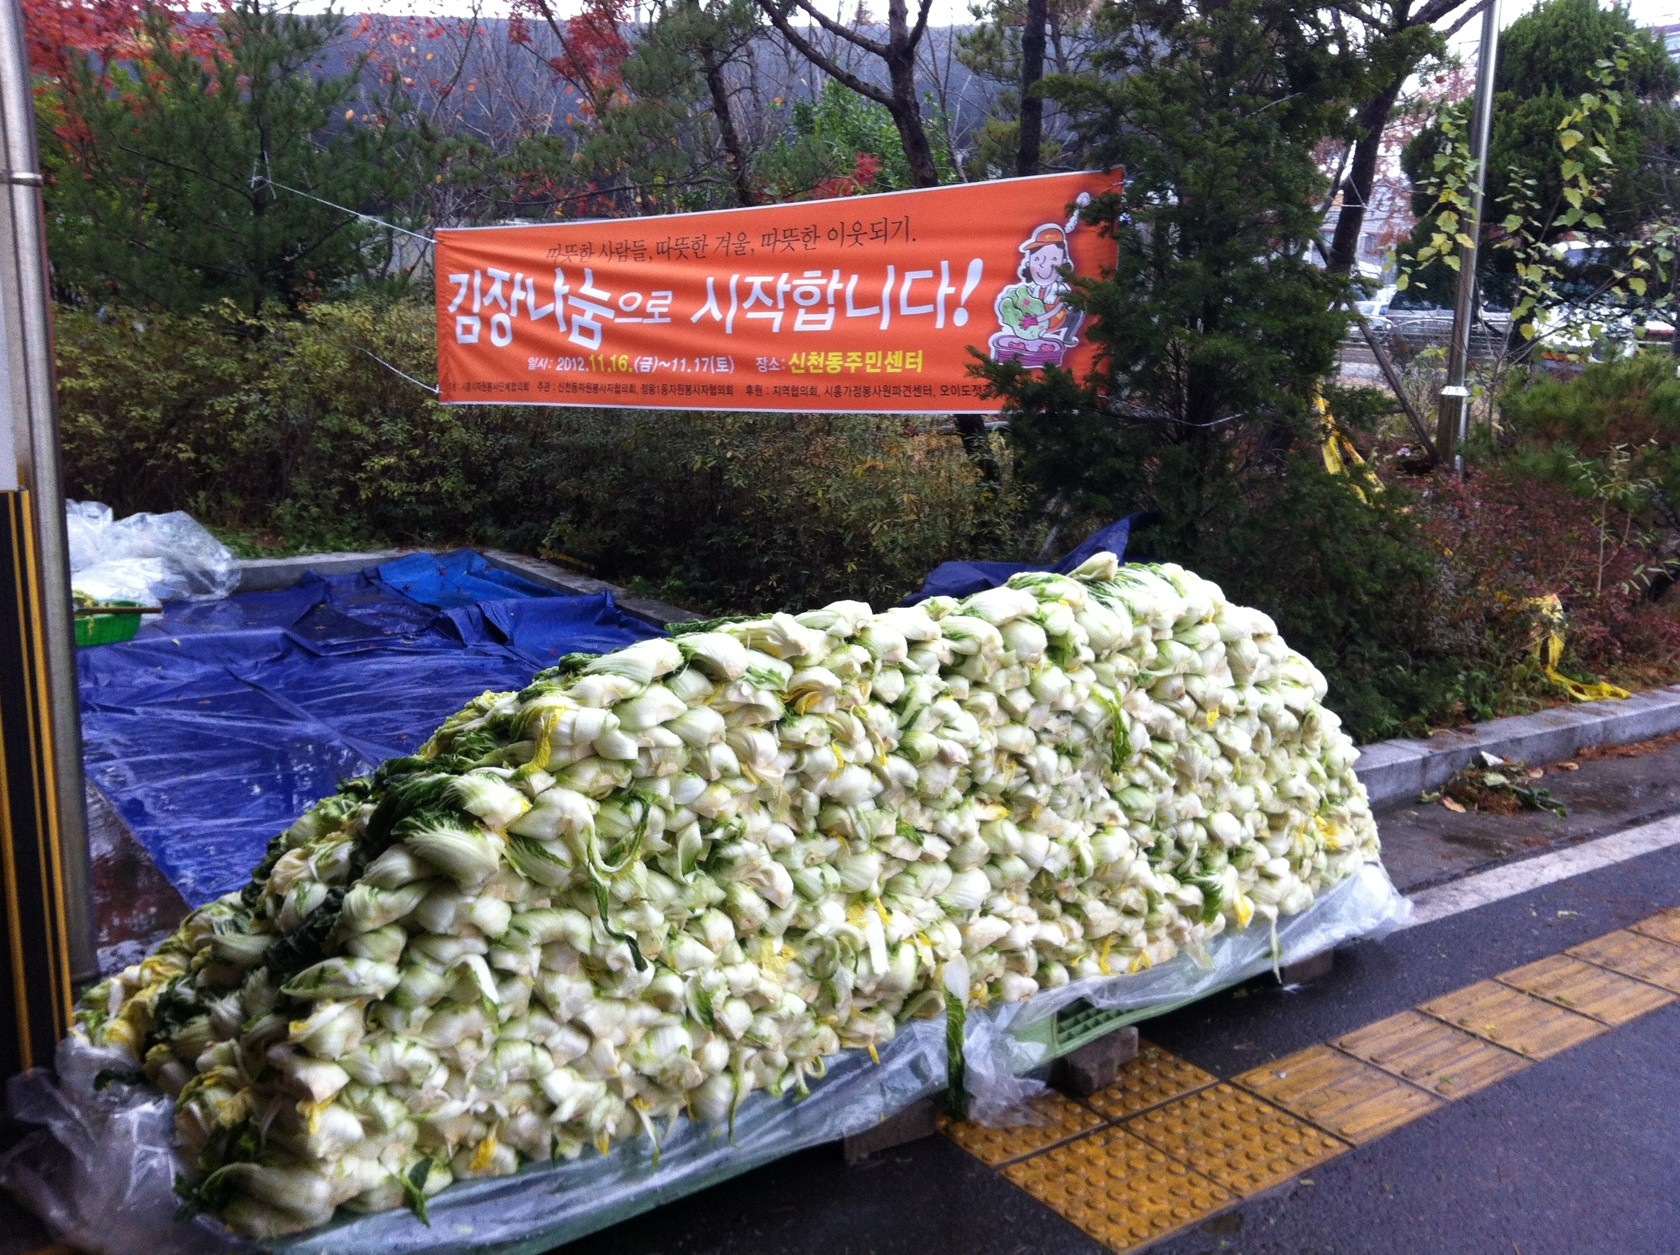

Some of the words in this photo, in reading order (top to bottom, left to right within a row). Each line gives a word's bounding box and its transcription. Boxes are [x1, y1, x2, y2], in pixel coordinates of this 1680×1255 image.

[547, 240, 595, 264] 따뜻한
[600, 238, 652, 264] 사람들,
[656, 233, 709, 262] 따뜻한
[713, 231, 755, 258] 겨울,
[760, 223, 821, 254] 따뜻한
[827, 214, 917, 248] 이웃되기.
[447, 266, 674, 351] 김장나눔으로
[690, 257, 984, 335] 시작합니다!
[527, 357, 553, 371] 일시:
[755, 355, 786, 373] 장소:
[788, 350, 924, 374] 신천동주민센터
[745, 384, 763, 398] 후원
[772, 385, 821, 399] 지역협의회,
[824, 385, 936, 398] 시흥가정봉사원파견센터,
